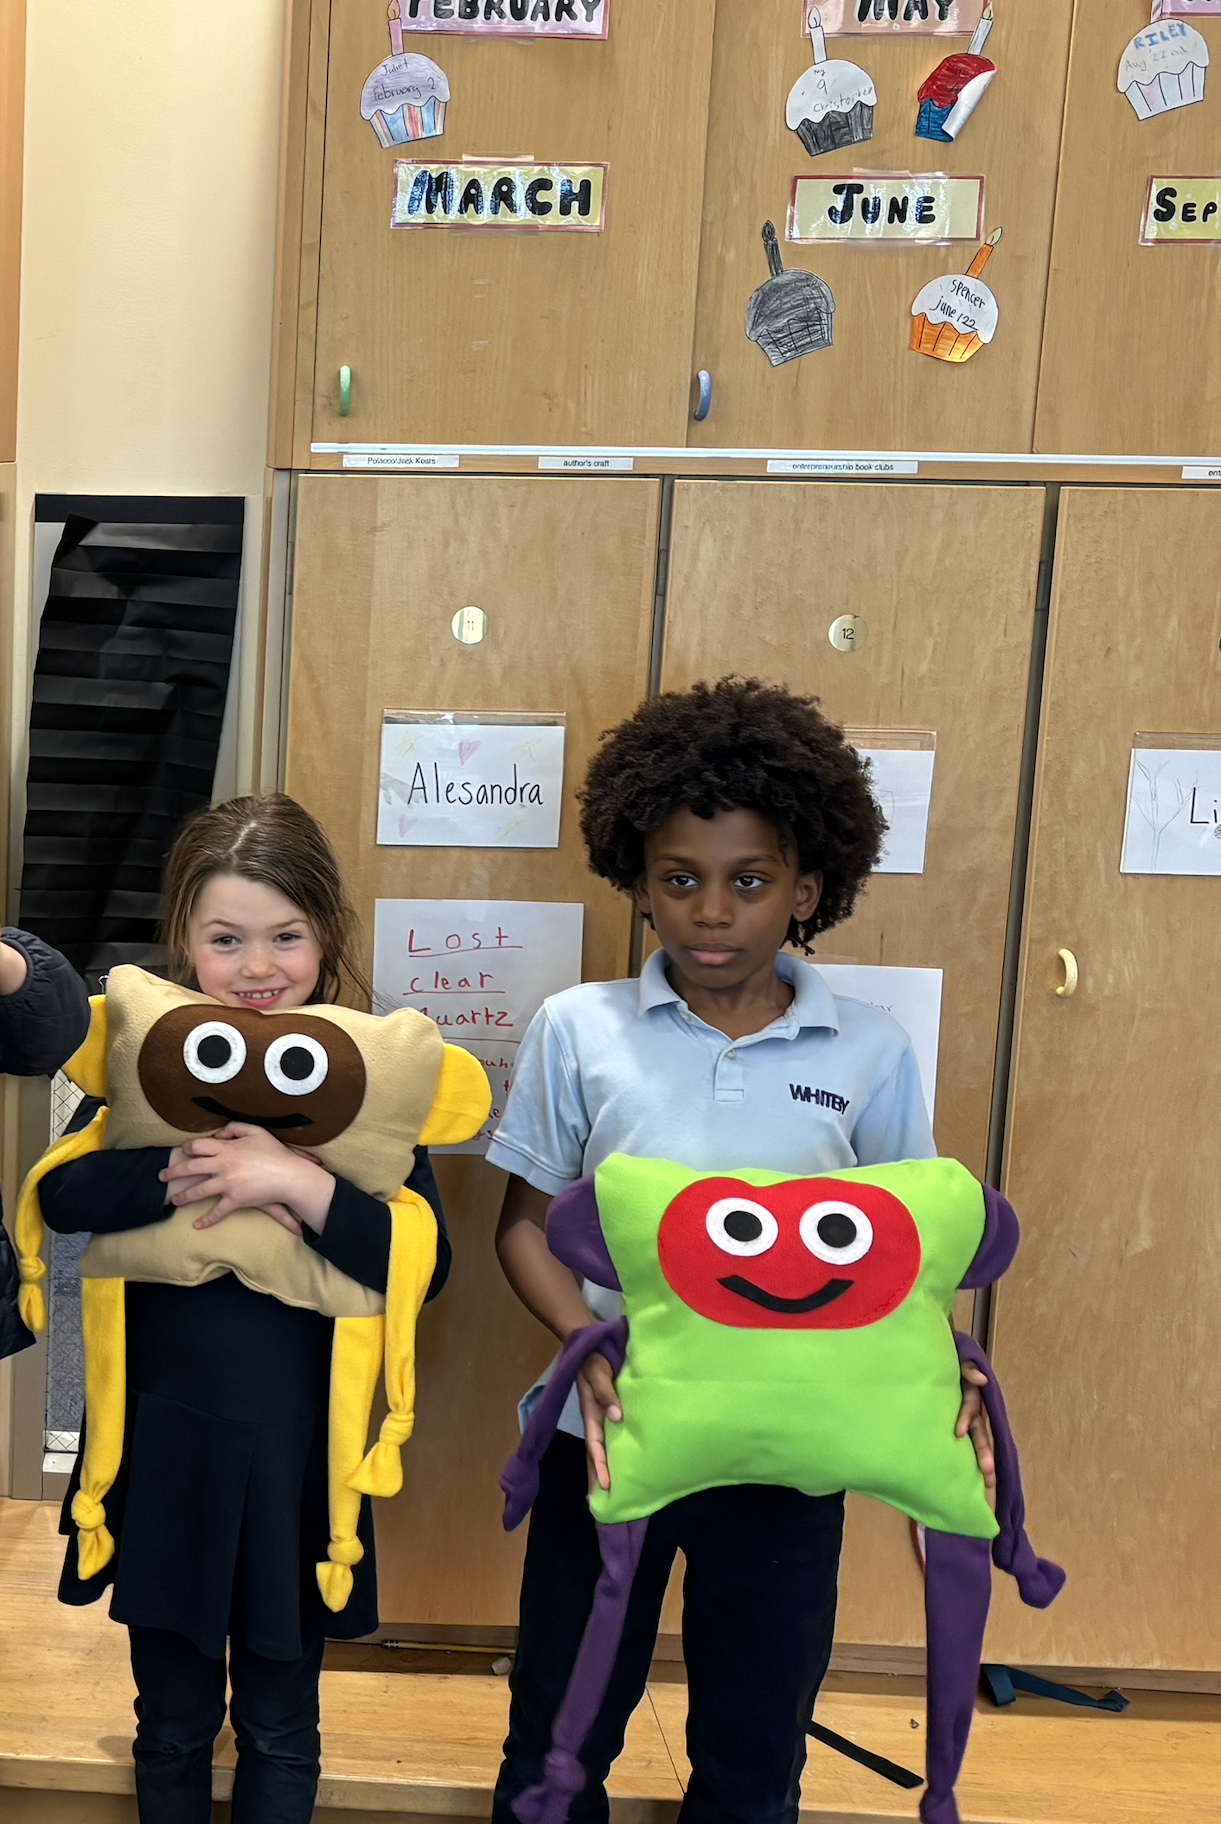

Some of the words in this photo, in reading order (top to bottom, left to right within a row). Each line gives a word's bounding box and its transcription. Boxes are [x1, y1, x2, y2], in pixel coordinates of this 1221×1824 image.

[1134, 23, 1187, 50] RILEY
[381, 58, 409, 76] Juliet
[1125, 60, 1147, 72] Aug
[407, 170, 592, 216] MARCH
[827, 183, 936, 225] JUNE
[855, 463, 872, 471] book
[874, 463, 894, 471] clubs
[842, 628, 855, 640] 12
[407, 762, 544, 805] Alesandra
[408, 927, 509, 952] Lost
[410, 971, 493, 993] clear
[789, 1083, 850, 1115] WHITBY
